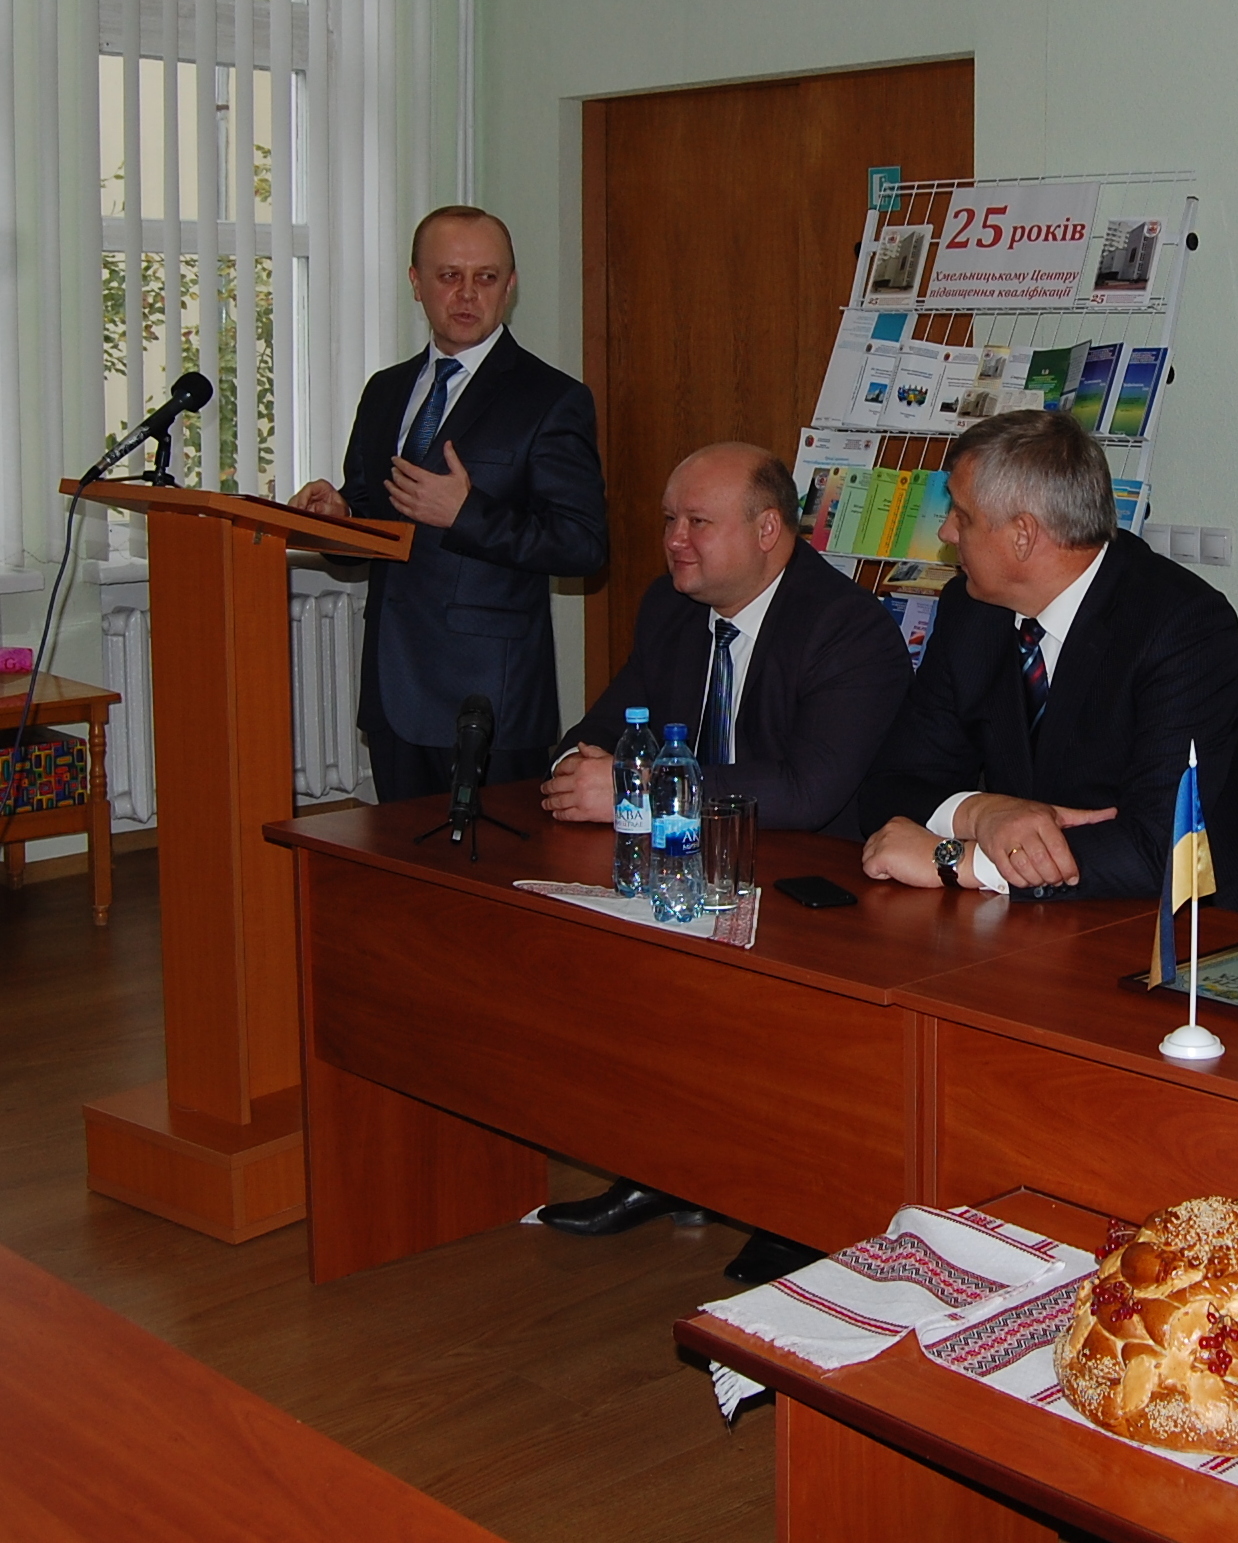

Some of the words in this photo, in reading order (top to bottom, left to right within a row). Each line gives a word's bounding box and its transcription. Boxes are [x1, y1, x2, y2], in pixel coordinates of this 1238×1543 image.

[945, 204, 1009, 249] 25
[1007, 217, 1086, 250] років
[932, 270, 1029, 284] Хмельницькому
[1030, 269, 1080, 284] Центру
[929, 287, 995, 299] підвищення
[997, 286, 1073, 300] кваліфікації
